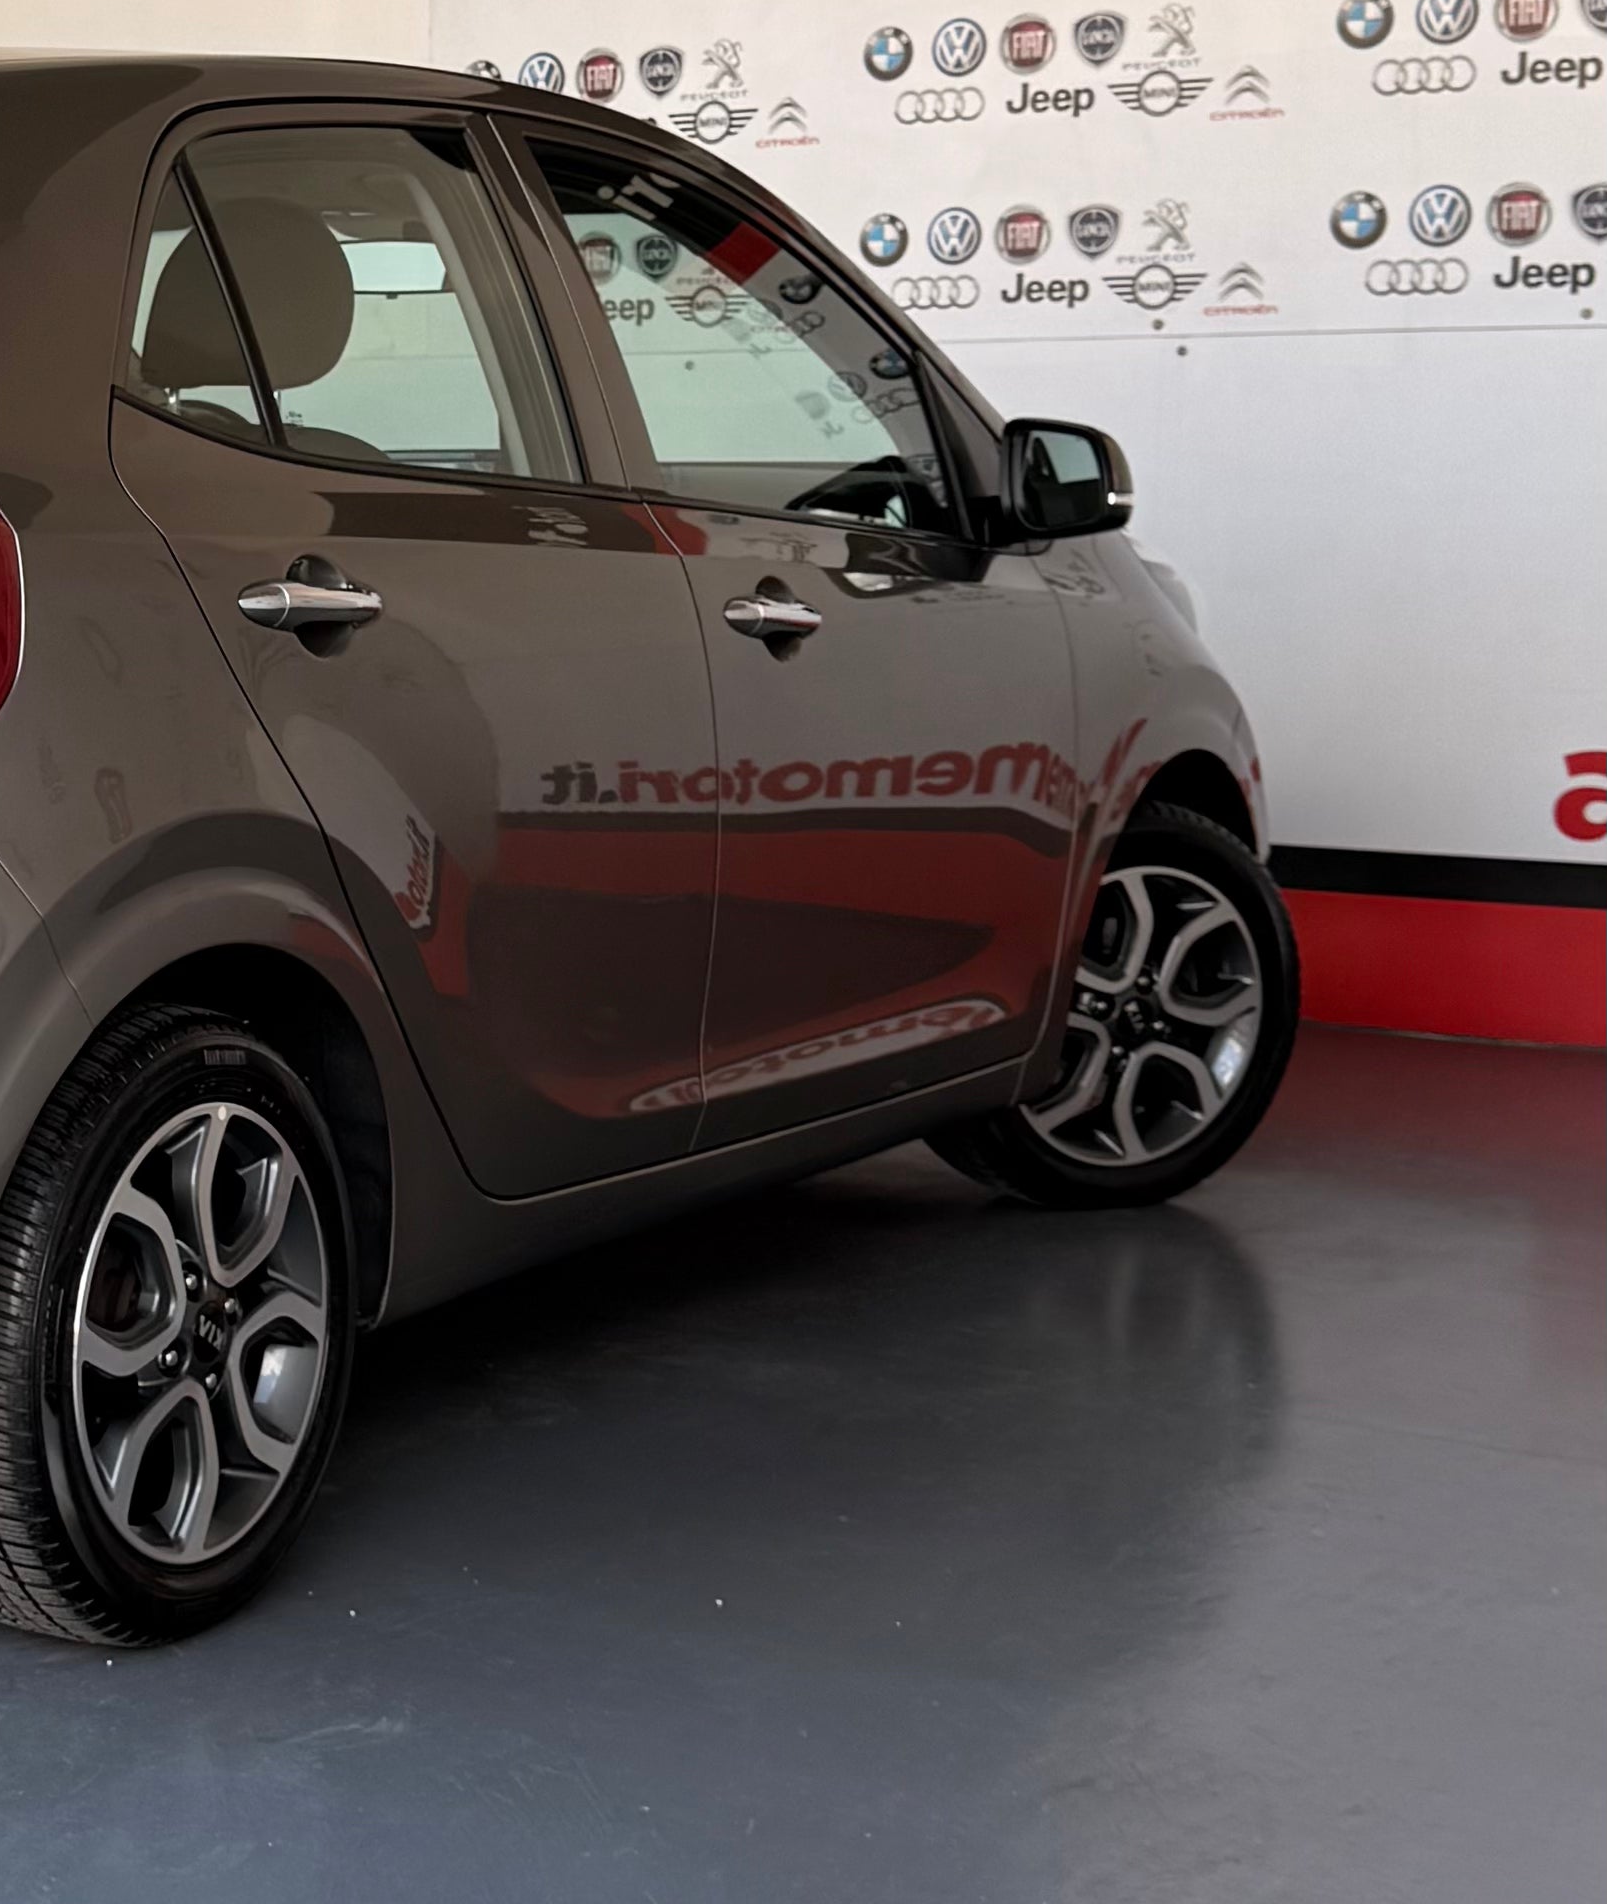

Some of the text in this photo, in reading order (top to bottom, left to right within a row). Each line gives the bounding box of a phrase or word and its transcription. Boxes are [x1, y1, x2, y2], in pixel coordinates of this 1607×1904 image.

[1012, 33, 1046, 59] FIAT
[586, 64, 618, 88] FIAT
[1500, 51, 1604, 89] Jeep
[1005, 83, 1095, 117] Jeep
[1502, 200, 1540, 230] FIAT
[1007, 222, 1042, 248] FIAT
[1001, 272, 1090, 308] Jeep
[1493, 256, 1597, 295] Jeep
[602, 298, 655, 327] eep
